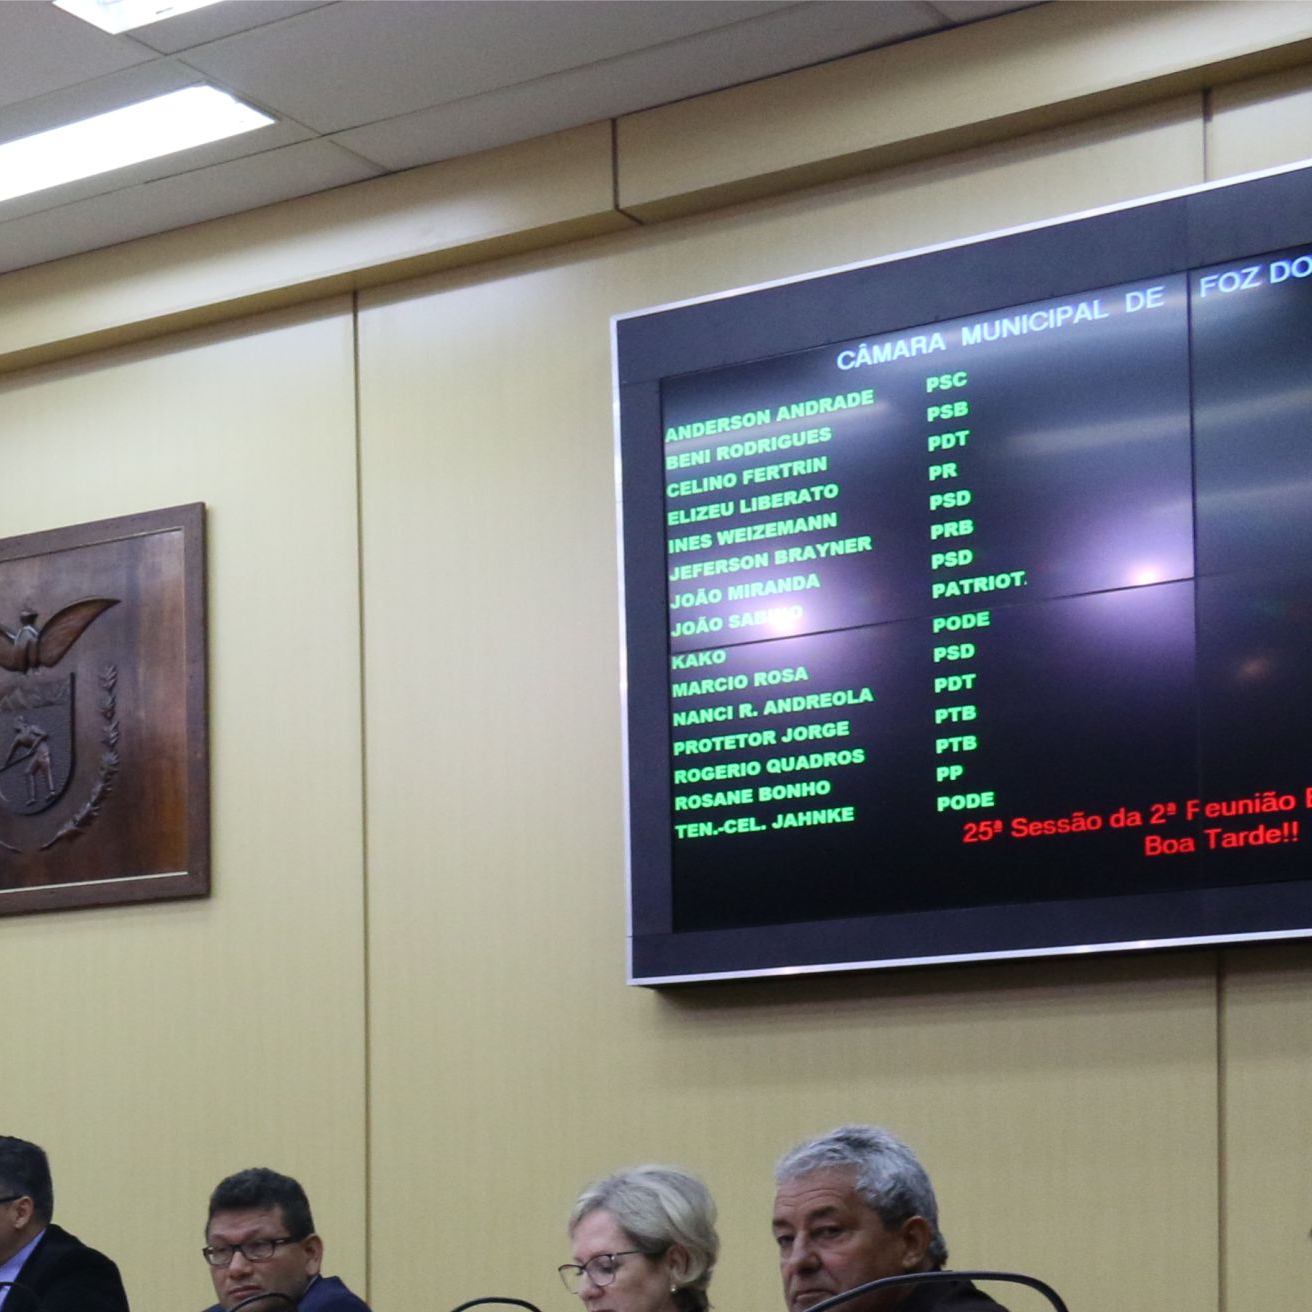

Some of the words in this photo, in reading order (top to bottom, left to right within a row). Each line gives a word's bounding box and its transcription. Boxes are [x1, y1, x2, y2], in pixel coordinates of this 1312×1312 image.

[836, 332, 946, 371] CÂMARA
[961, 300, 1109, 347] MUNICIPAL
[1125, 286, 1165, 313] DE
[1199, 265, 1261, 299] FOZ
[1270, 255, 1312, 284] DO
[927, 371, 967, 392] PSC
[665, 410, 770, 443] ANDERSON
[776, 389, 874, 422] ANDRADE
[927, 401, 969, 422] PSB
[665, 450, 710, 470] BENI
[717, 427, 832, 461] RODRIGUES
[928, 430, 969, 451] PDT
[666, 473, 737, 498] CELINO
[743, 456, 827, 484] FERTRIN
[929, 462, 957, 480] PR
[667, 502, 734, 526] ELIZEU
[740, 484, 839, 513] LIBERATO
[929, 490, 971, 510] PSD
[669, 534, 712, 554] INES
[717, 512, 838, 546] WEIZEMANN
[931, 519, 974, 540] PRB
[669, 552, 769, 581] JEFERSON
[775, 536, 872, 564] BRAYNER
[931, 549, 973, 569] PSD
[671, 588, 722, 609] JOÃO
[728, 574, 820, 601] MIRANDA
[671, 616, 723, 637] JOÃO
[933, 611, 990, 633] PODE
[672, 650, 726, 669] KAKO
[933, 644, 975, 662] PSD
[673, 675, 748, 697] MARCIO
[754, 666, 808, 687] ROSA
[934, 674, 976, 693] PDT
[673, 706, 733, 726] NANCI
[739, 703, 758, 718] R.
[763, 688, 873, 715] ANDREOLA
[935, 705, 977, 724] PTB
[673, 730, 776, 756] PROTETOR
[781, 720, 849, 743] JORGE
[936, 736, 977, 754] PTB
[675, 761, 761, 784] ROGERIO
[766, 748, 865, 774] QUADROS
[937, 765, 963, 782] PP
[675, 788, 753, 810] ROSANE
[759, 780, 831, 801] BONHO
[937, 792, 995, 811] PODE
[675, 817, 767, 839] TEN.-CEL.
[772, 806, 855, 828] JAHNKE
[1011, 812, 1102, 838] Sessão
[1109, 808, 1142, 828] da
[1144, 835, 1195, 856] Boa
[1205, 822, 1299, 850] Tarde!!
